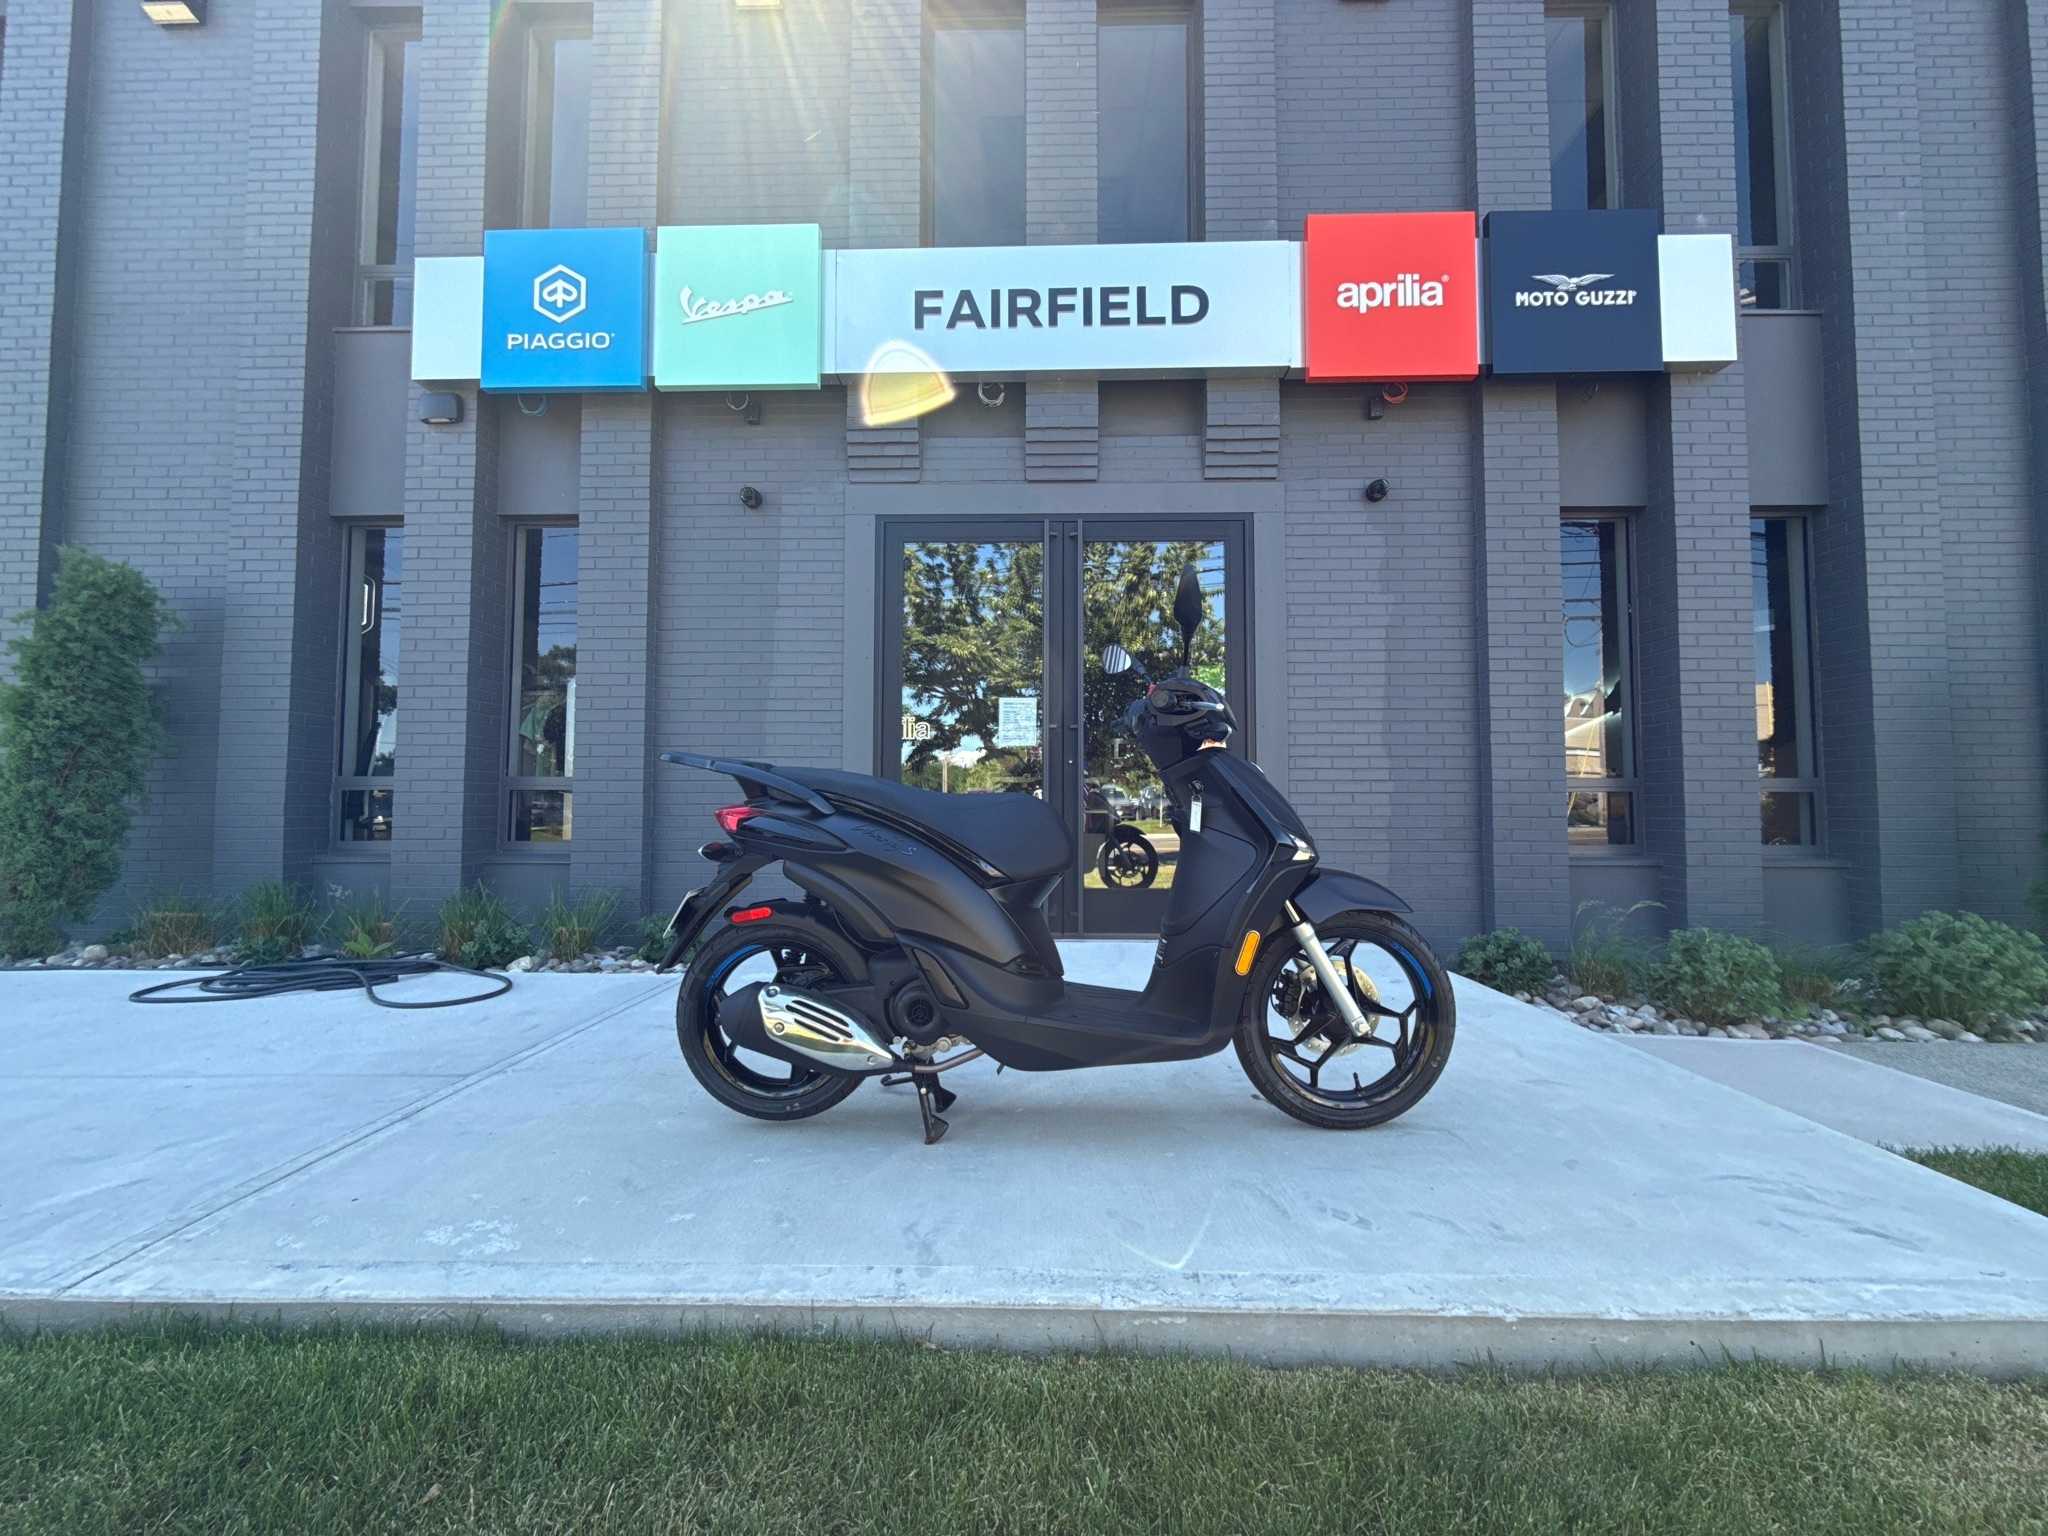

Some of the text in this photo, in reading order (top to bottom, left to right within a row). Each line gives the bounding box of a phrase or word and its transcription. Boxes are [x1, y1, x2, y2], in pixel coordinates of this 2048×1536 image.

[680, 284, 793, 325] Vespa
[914, 284, 1210, 330] FAIRFIELD
[1336, 273, 1444, 314] aprilia
[1515, 290, 1634, 307] MOTO GUZZI
[507, 332, 611, 350] PIAGGIO
